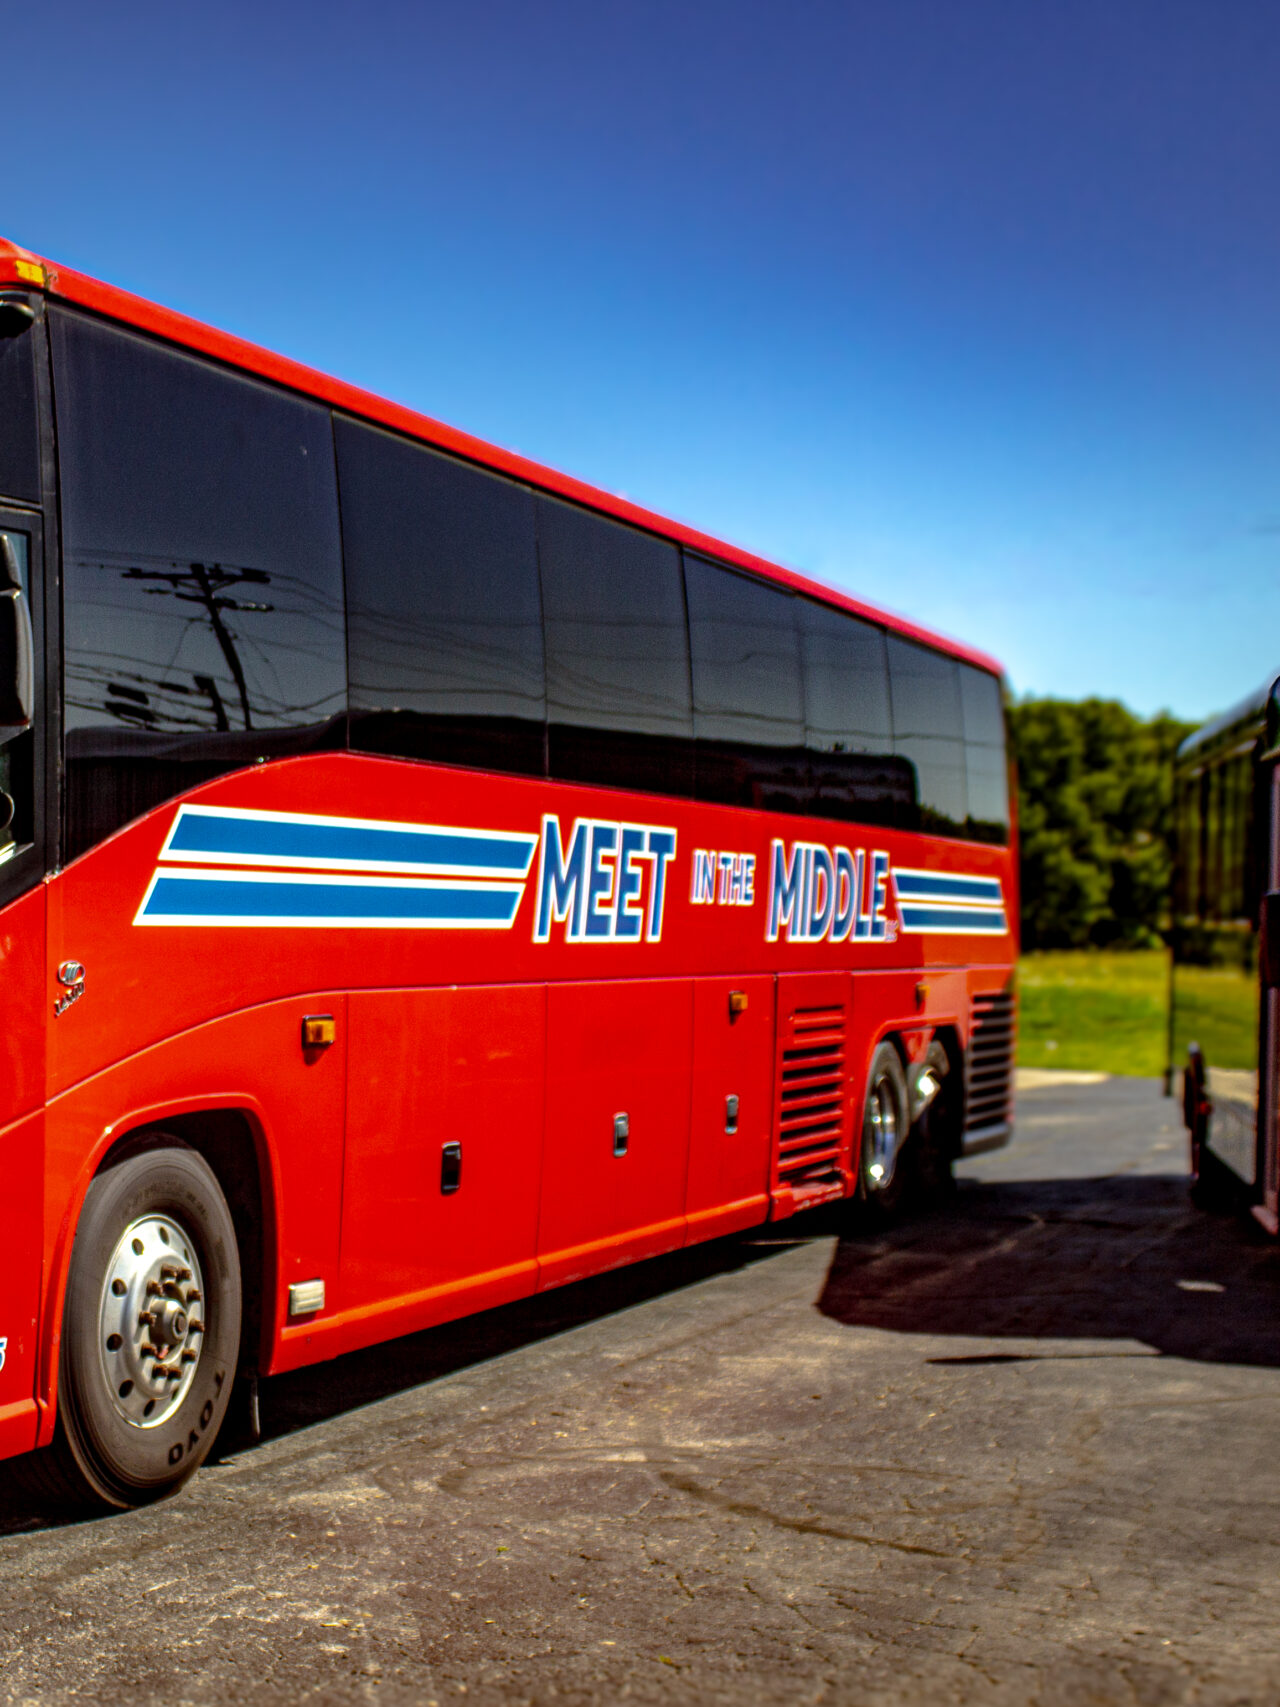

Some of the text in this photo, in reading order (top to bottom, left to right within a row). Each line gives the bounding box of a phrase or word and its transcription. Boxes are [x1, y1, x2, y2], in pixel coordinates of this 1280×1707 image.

[533, 814, 891, 944] MEET IN THE MIDDLE
[168, 1369, 226, 1466] TOYO
